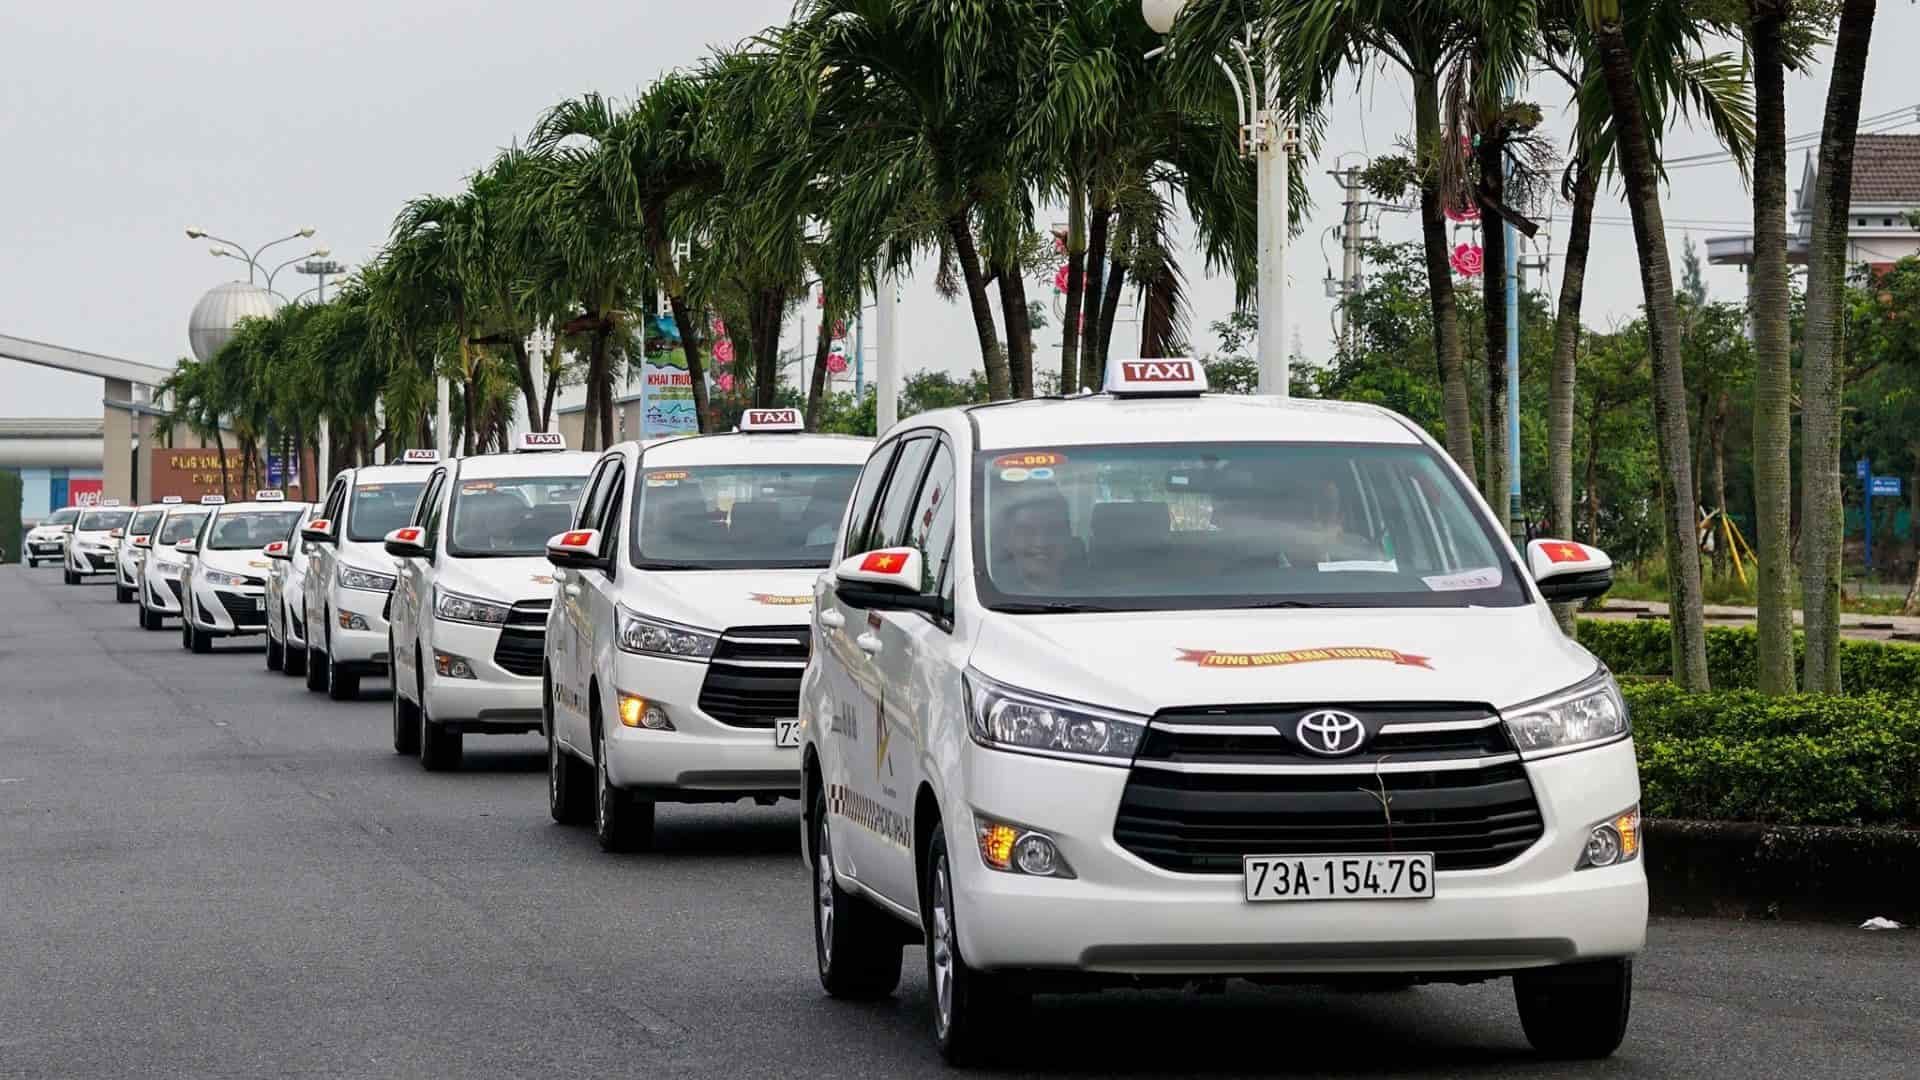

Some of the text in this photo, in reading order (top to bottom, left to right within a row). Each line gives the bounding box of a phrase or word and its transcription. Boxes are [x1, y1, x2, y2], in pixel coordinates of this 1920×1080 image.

[1127, 362, 1191, 379] TAXI
[647, 374, 668, 385] KHAI
[751, 411, 793, 423] TAXI
[528, 434, 561, 444] TAXI
[408, 450, 435, 459] TAXI
[1252, 859, 1427, 896] 73A-154.76
